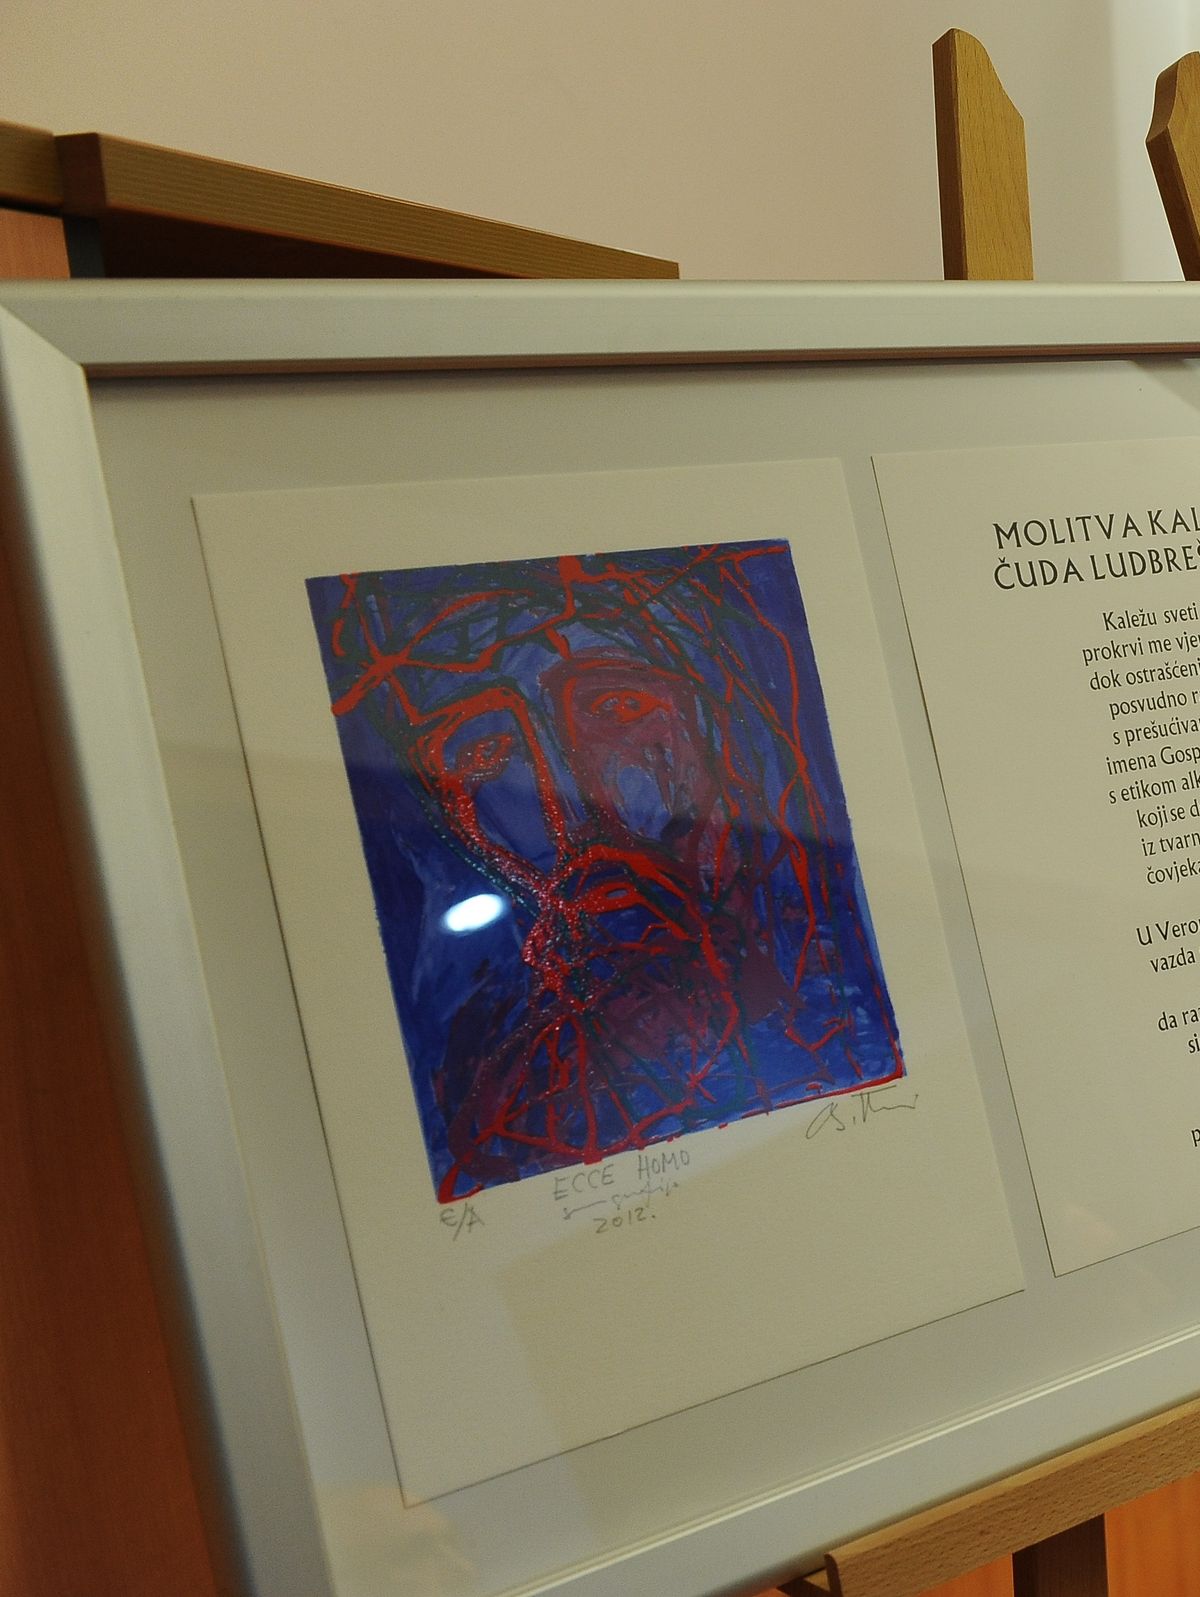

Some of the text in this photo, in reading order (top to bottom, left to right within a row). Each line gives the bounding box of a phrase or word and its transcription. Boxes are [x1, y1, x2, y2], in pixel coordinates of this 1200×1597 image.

[992, 512, 1143, 549] MOLITVA
[993, 557, 1085, 590] ČUDA
[1102, 602, 1200, 631] Kaležu sveti
[1082, 636, 1144, 666] prokrvi
[1148, 636, 1172, 654] me
[1089, 670, 1122, 691] dok
[1109, 690, 1188, 720] posvudno
[1112, 730, 1121, 745] s
[1105, 753, 1157, 775] imena
[1108, 790, 1117, 804] s
[1120, 778, 1177, 802] etikom
[1136, 805, 1169, 828] koji
[1170, 807, 1186, 822] se
[1141, 838, 1156, 857] iz
[1136, 925, 1153, 946] U
[1150, 948, 1196, 973] vazda
[1157, 1012, 1178, 1032] da
[551, 1163, 615, 1201] ECCE
[637, 1149, 691, 1180] HOMO
